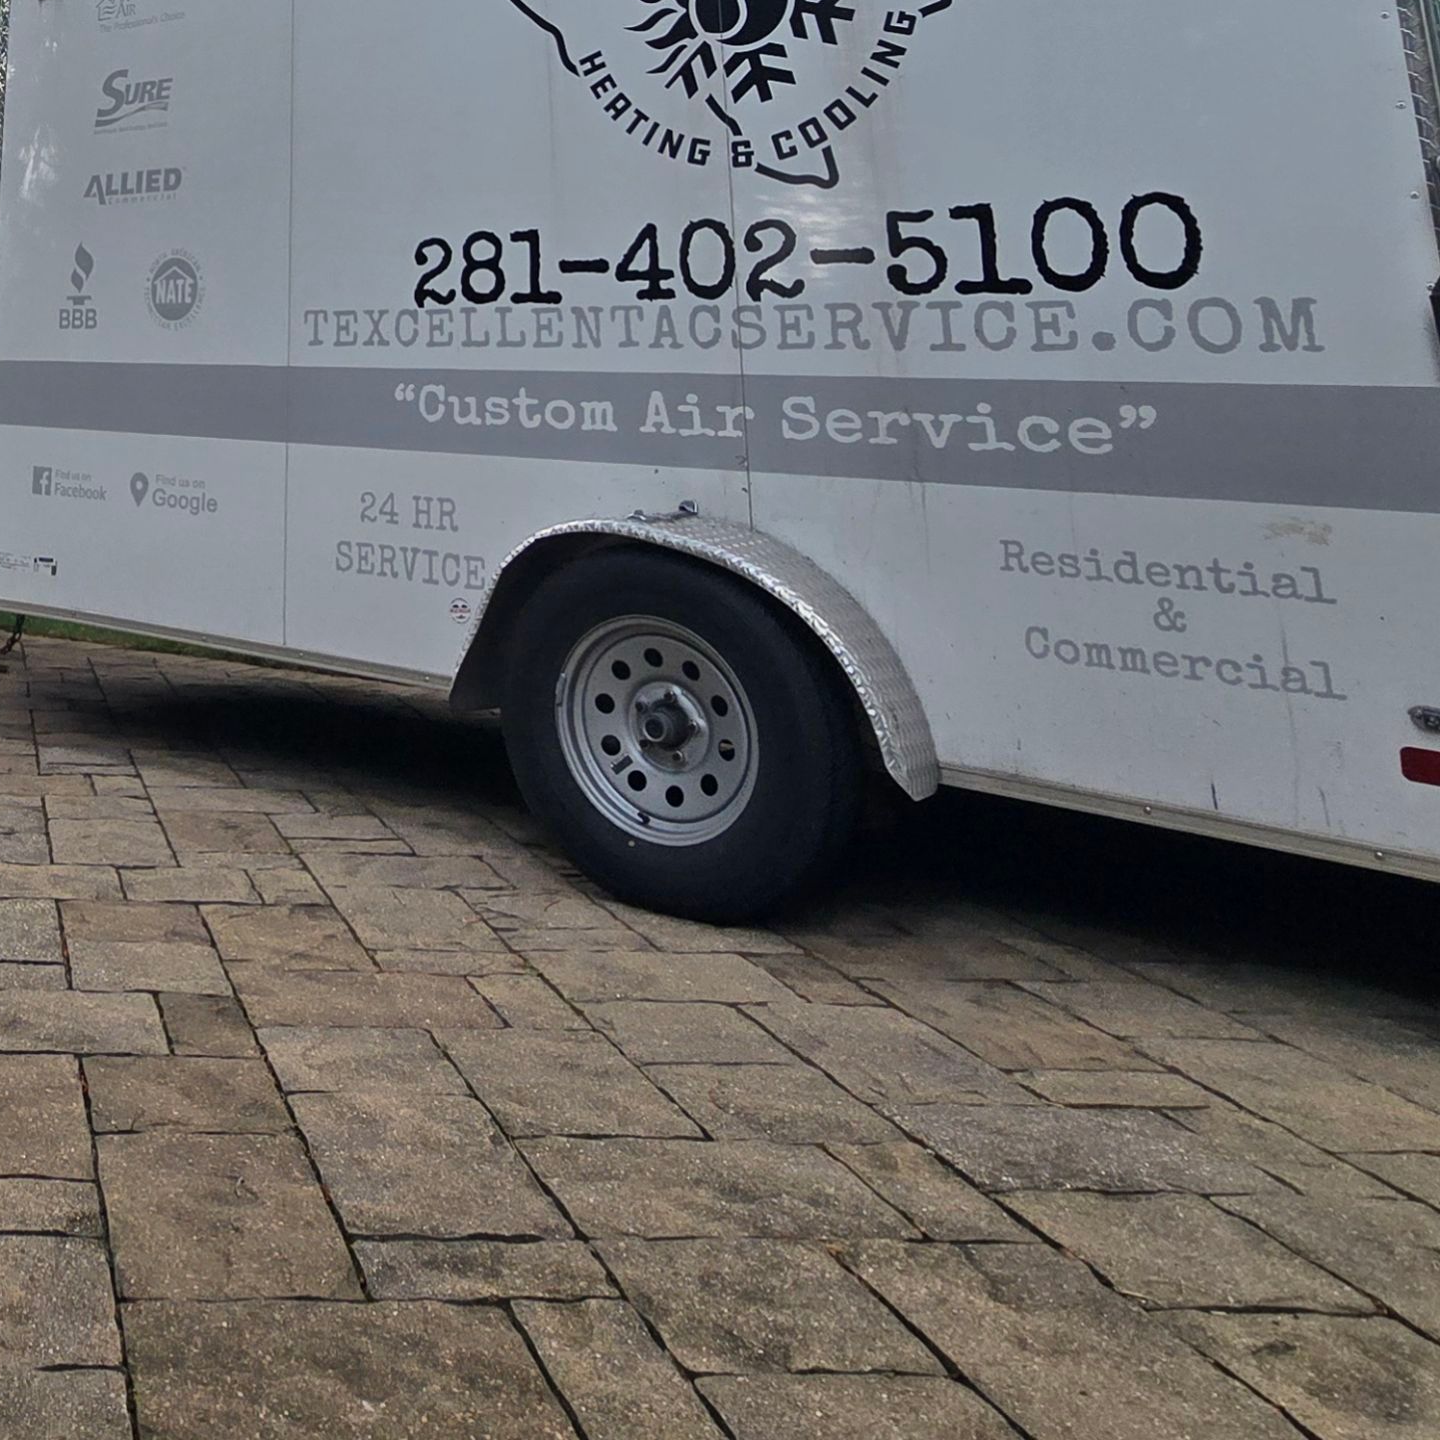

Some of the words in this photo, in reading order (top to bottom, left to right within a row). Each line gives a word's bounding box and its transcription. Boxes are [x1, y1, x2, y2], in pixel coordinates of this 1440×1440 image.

[116, 3, 136, 18] AIR
[97, 69, 173, 117] SURE
[578, 50, 711, 166] HEATING
[732, 141, 754, 168] &
[772, 10, 917, 161] COOLING
[83, 168, 182, 205] ALLIED
[414, 192, 1203, 308] 281-402-5100
[155, 278, 194, 304] NATE
[59, 308, 98, 329] BBB
[304, 297, 1325, 354] TEXCELLENTACSERVICE.COM
[640, 391, 751, 439] Air
[55, 482, 107, 501] Facebook
[152, 488, 218, 516] Google
[156, 474, 176, 486] Find
[178, 479, 190, 488] us
[192, 480, 205, 489] on
[360, 491, 398, 525] 24
[412, 494, 459, 533] HR
[335, 540, 487, 590] SERVICE
[999, 539, 1337, 605] Residential
[1153, 597, 1187, 633] &
[1024, 626, 1348, 701] Commercial
